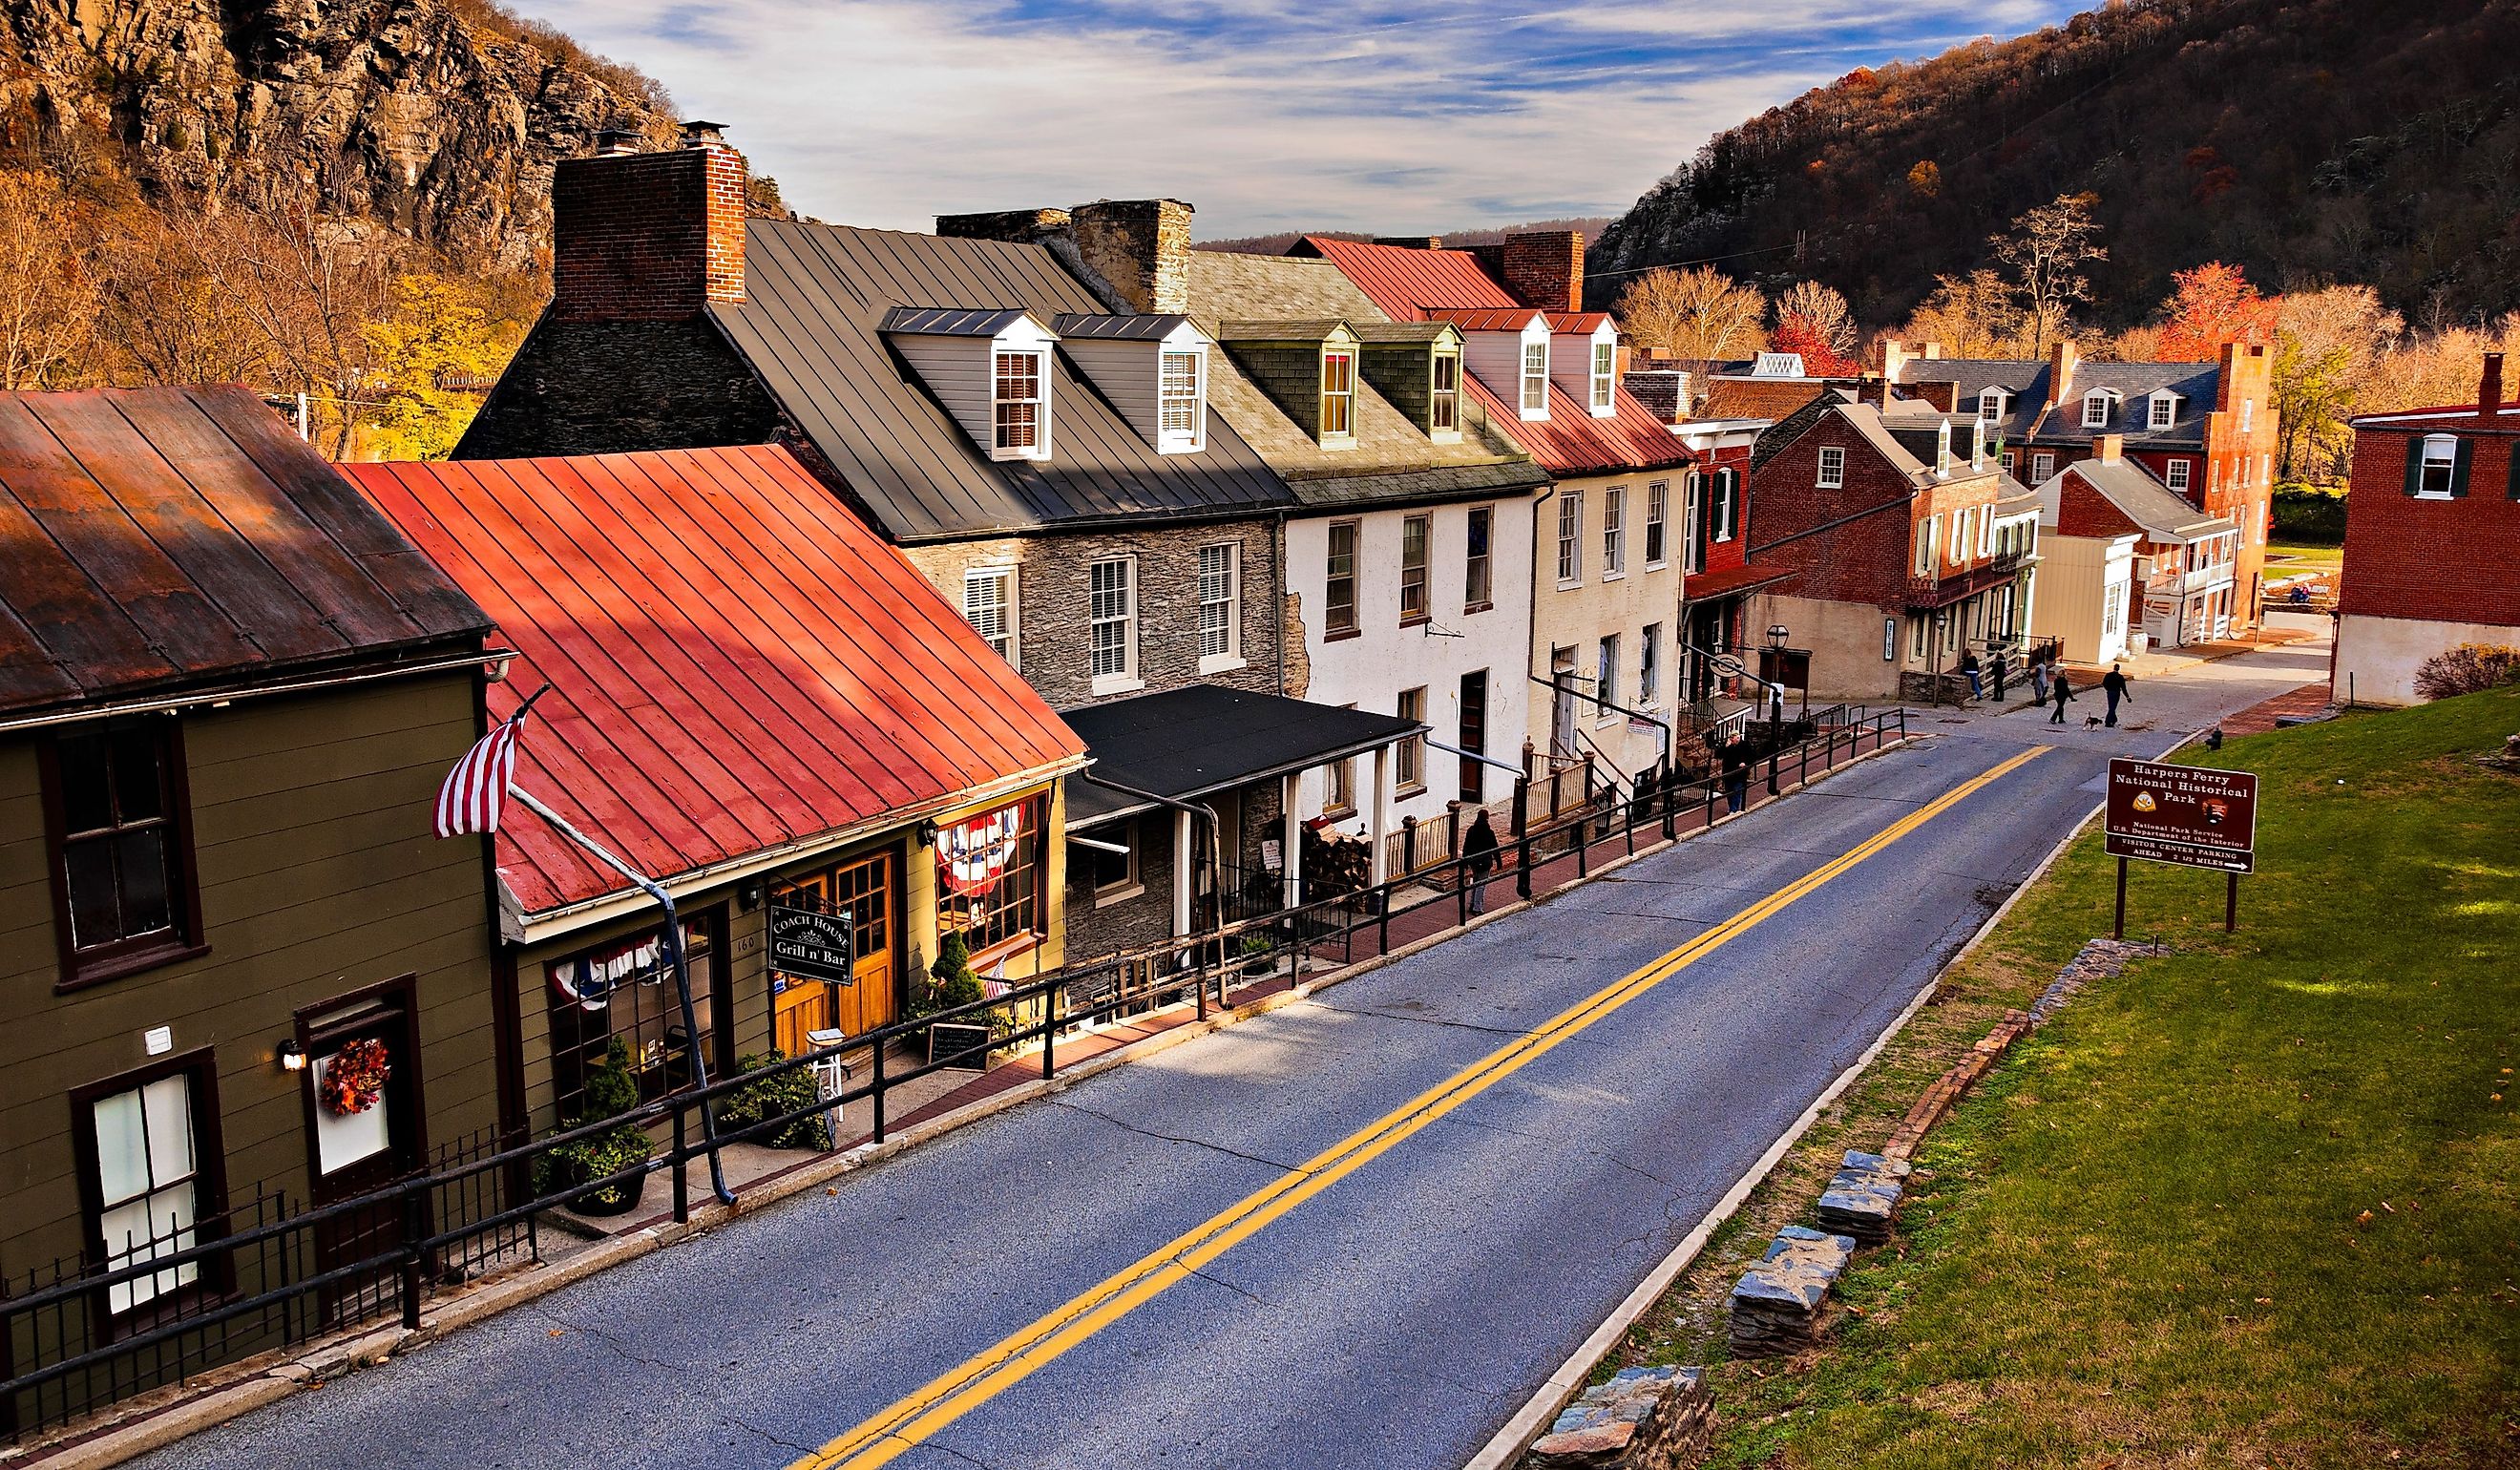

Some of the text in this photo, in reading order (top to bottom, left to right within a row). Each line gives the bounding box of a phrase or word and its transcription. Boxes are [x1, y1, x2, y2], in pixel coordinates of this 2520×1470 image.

[2134, 765, 2230, 786] Harpers Ferry
[2115, 774, 2248, 798] National Historical
[2163, 791, 2196, 805] Park
[2132, 821, 2224, 838] National Park Service
[2132, 828, 2179, 840] Department
[2210, 838, 2245, 848] Interior
[2121, 838, 2237, 860] VISITOR CENTER PARKING
[2132, 849, 2163, 858] AHEAD
[2196, 857, 2224, 867] MILES
[773, 915, 810, 934] COACH
[814, 916, 850, 949] HOUSE
[738, 936, 754, 953] 160
[776, 941, 846, 966] Grill n' Bar
